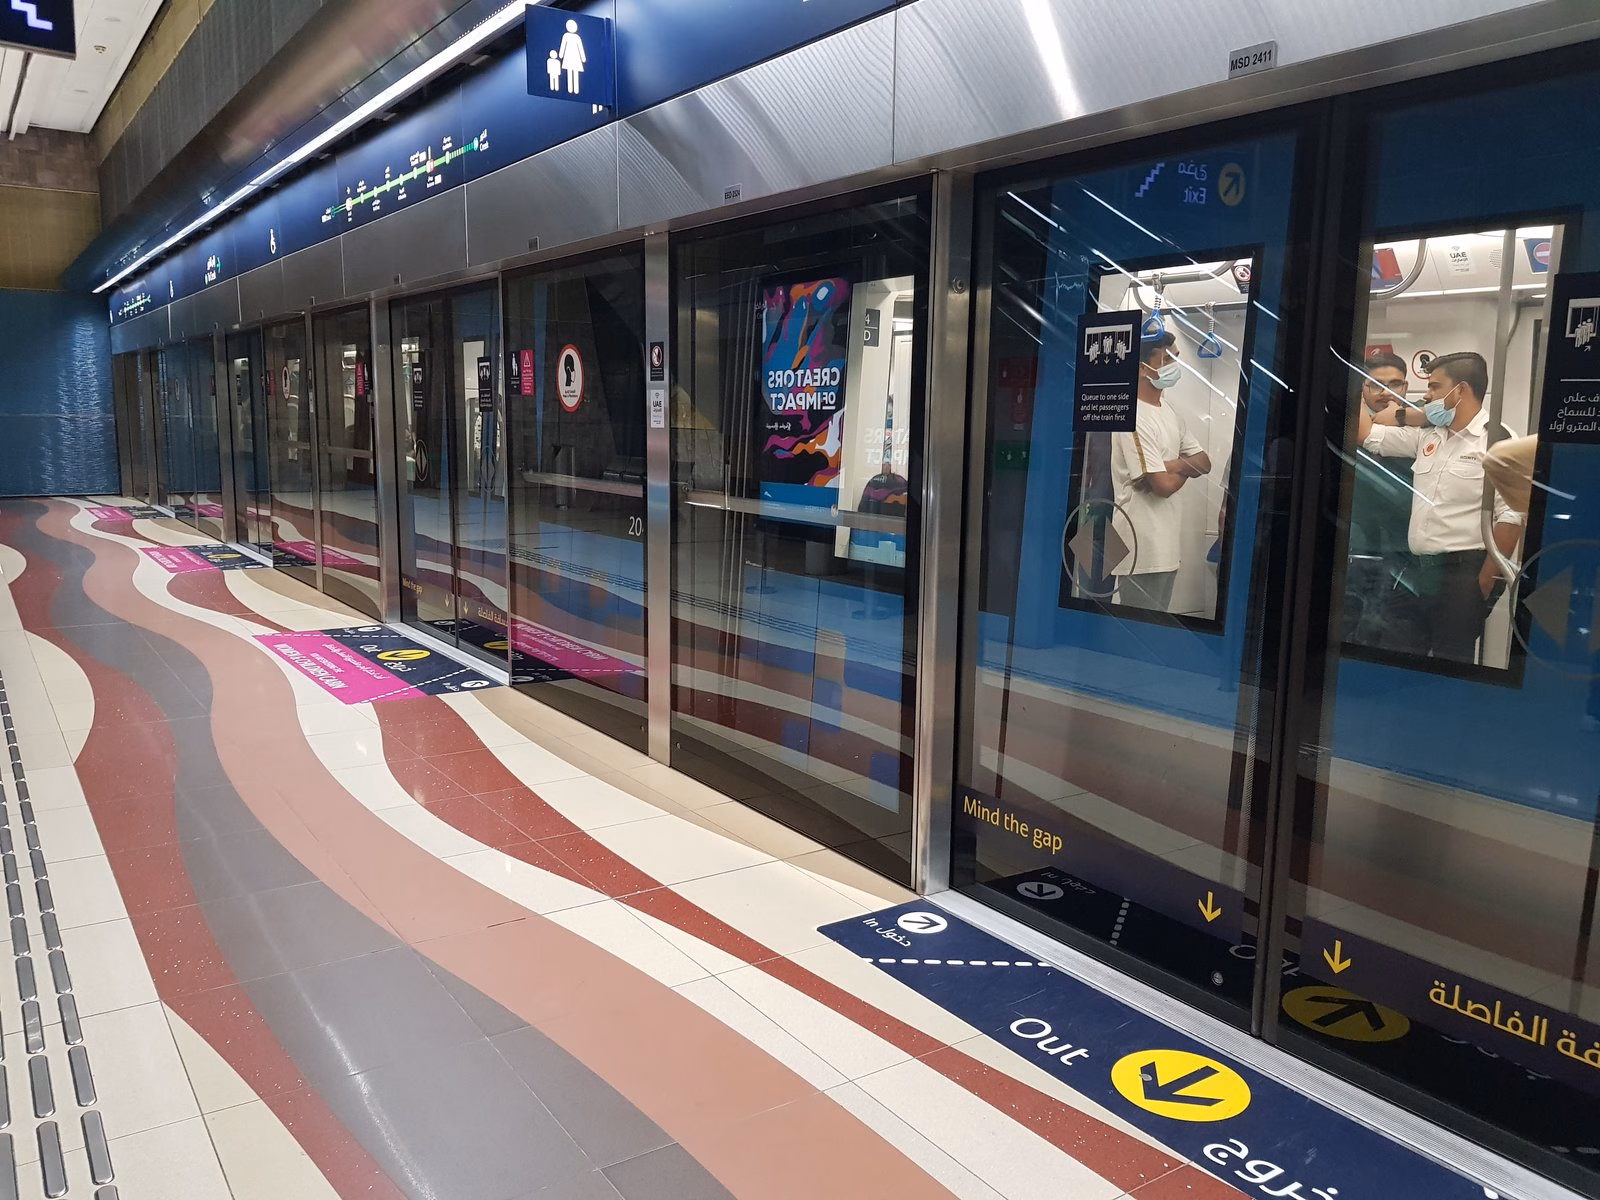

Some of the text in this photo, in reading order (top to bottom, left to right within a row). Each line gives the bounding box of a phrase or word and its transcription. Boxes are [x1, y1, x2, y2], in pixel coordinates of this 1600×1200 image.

[1231, 50, 1272, 71] MSD 2411
[1449, 251, 1467, 259] UAE
[1081, 392, 1130, 401] Queue to one side
[1099, 404, 1129, 412] passengers
[1083, 413, 1091, 421] off
[1101, 413, 1113, 421] train
[1114, 413, 1126, 421] first
[963, 795, 1062, 855] Mind the gap
[862, 918, 879, 927] In
[875, 927, 911, 947] دخول
[1429, 980, 1548, 1046] الفاصلة
[1010, 1018, 1090, 1066] Out
